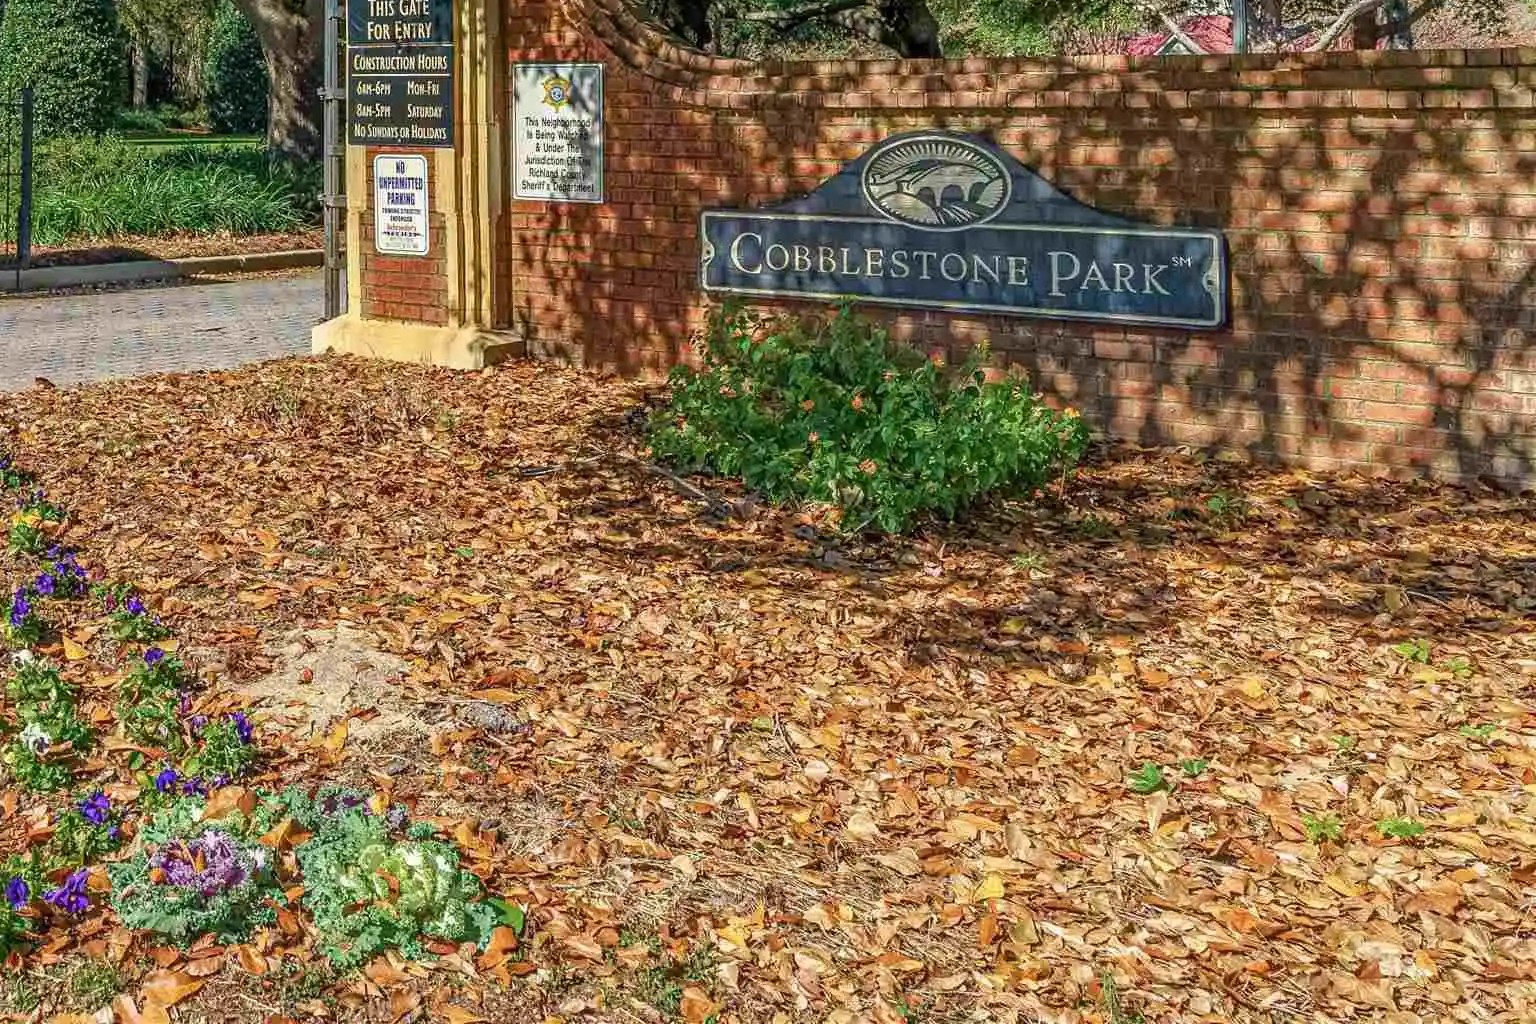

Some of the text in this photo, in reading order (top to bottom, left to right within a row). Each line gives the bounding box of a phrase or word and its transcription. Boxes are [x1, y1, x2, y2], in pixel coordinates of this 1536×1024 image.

[367, 21, 432, 40] FOR ENTRY
[354, 54, 448, 70] CONSTRUCTION HOURS
[356, 81, 391, 95] 6AM-6PM
[407, 103, 443, 117] SATURDAY
[354, 123, 447, 139] NO SUNDAYS OR HOLIDAYS
[395, 161, 405, 174] NO
[379, 176, 423, 190] UNPERMITTED
[387, 192, 415, 205] PARKING
[730, 232, 1028, 287] COBBLESTONE
[1048, 251, 1171, 296] PARK
